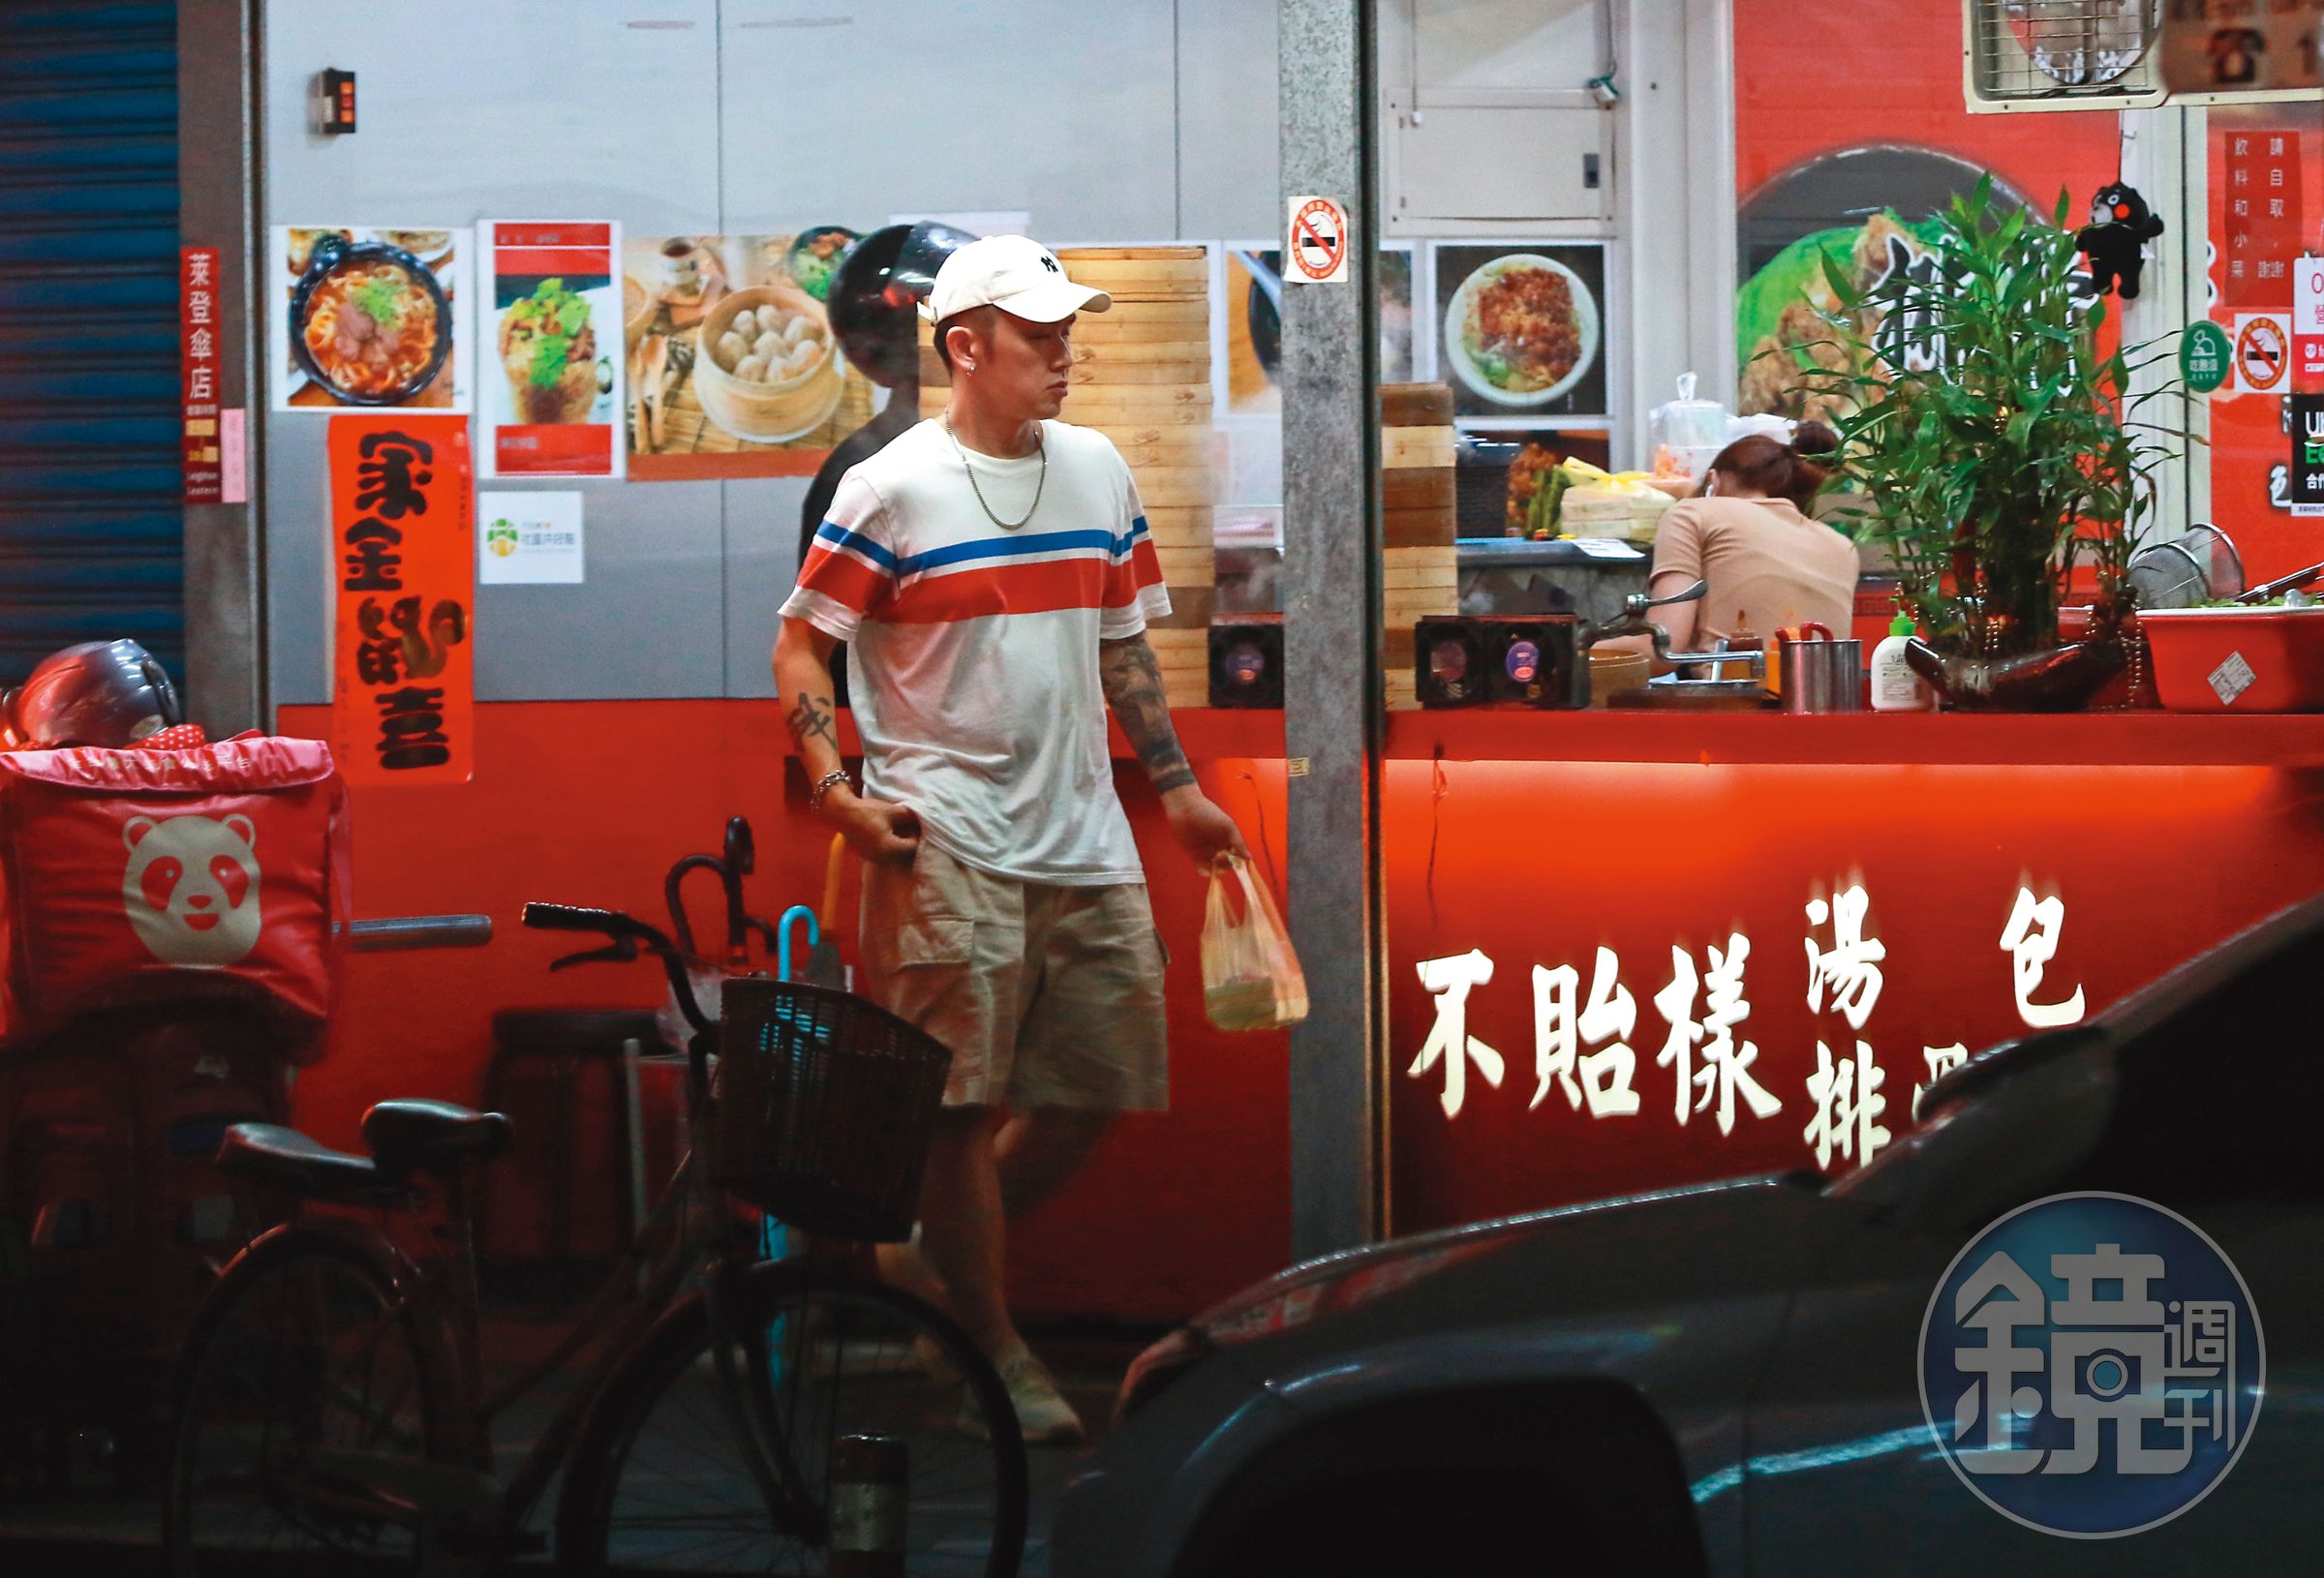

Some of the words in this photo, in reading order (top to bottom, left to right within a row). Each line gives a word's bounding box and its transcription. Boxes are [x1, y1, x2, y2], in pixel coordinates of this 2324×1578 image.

[2231, 138, 2248, 278] 飲料和小菜
[188, 253, 213, 399] 萊登傘店
[2306, 441, 2324, 464] E
[1408, 932, 1782, 1137] 不貽樣
